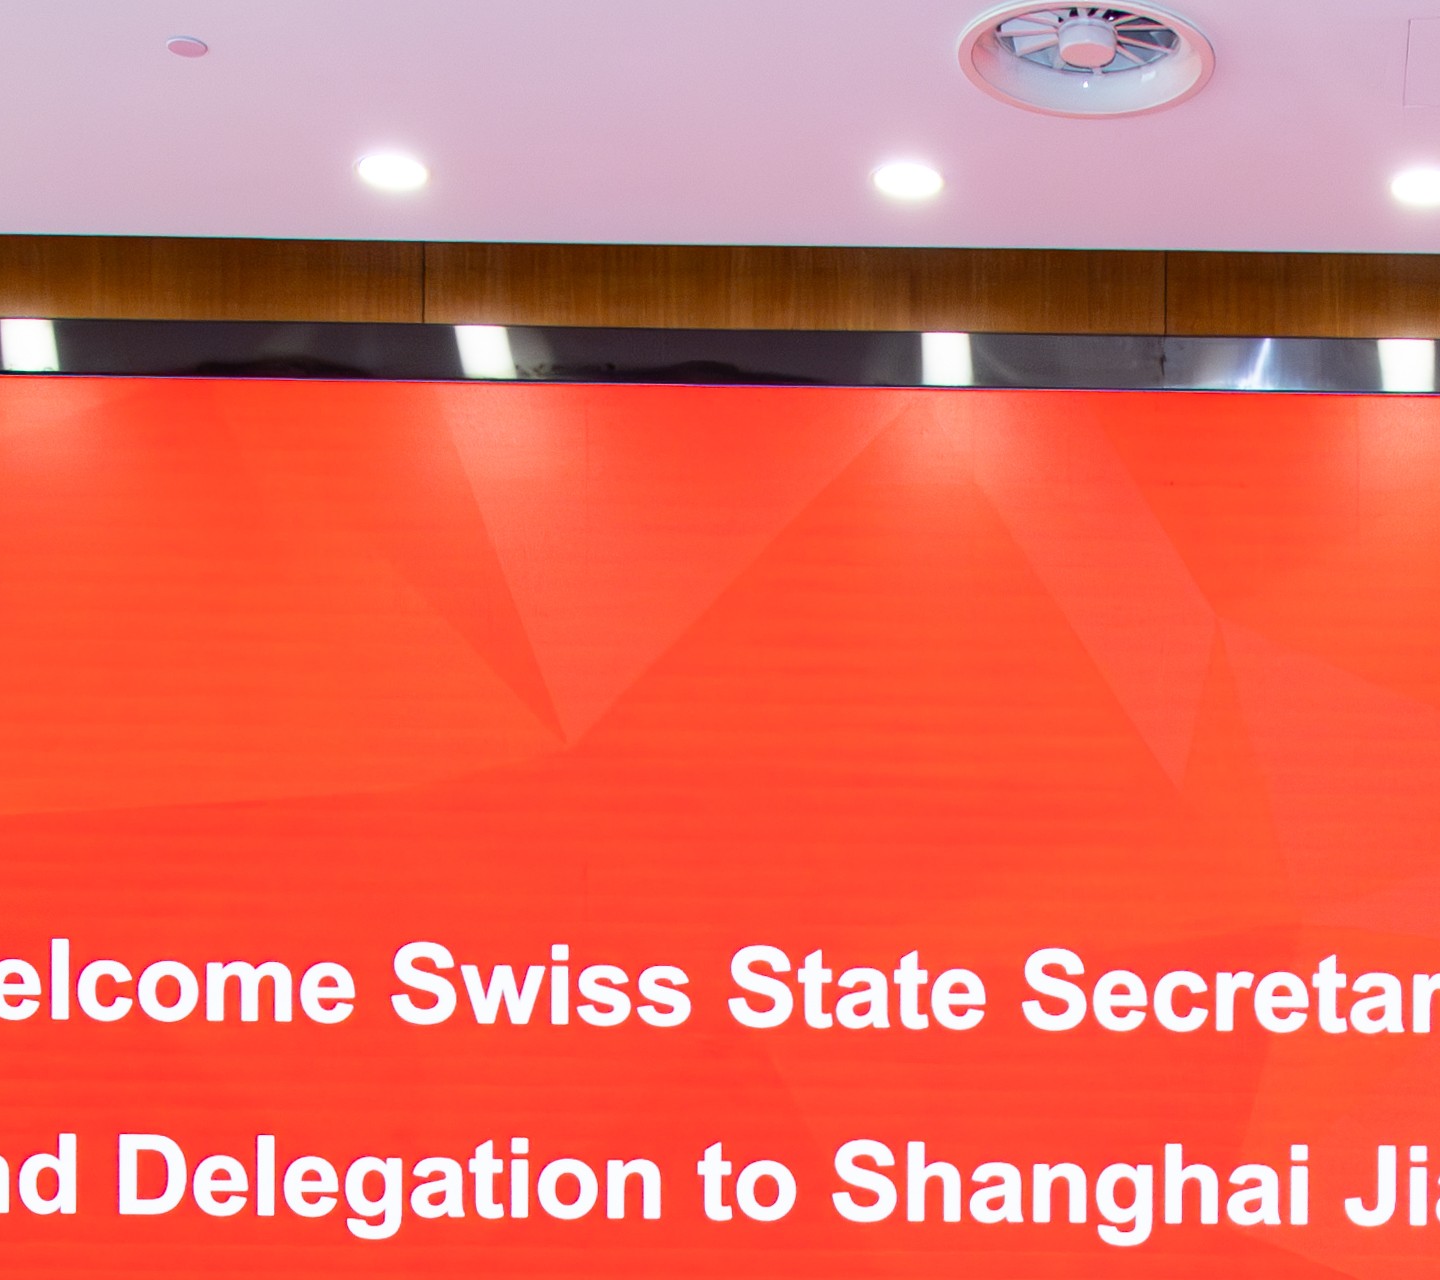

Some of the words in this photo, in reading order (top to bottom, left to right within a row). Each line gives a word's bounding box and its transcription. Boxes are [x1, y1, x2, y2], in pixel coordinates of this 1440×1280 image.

[391, 941, 692, 1028] Swiss
[727, 944, 987, 1031] State
[119, 1133, 662, 1240] Delegation
[697, 1142, 797, 1222] to
[831, 1138, 1309, 1247] Shanghai
